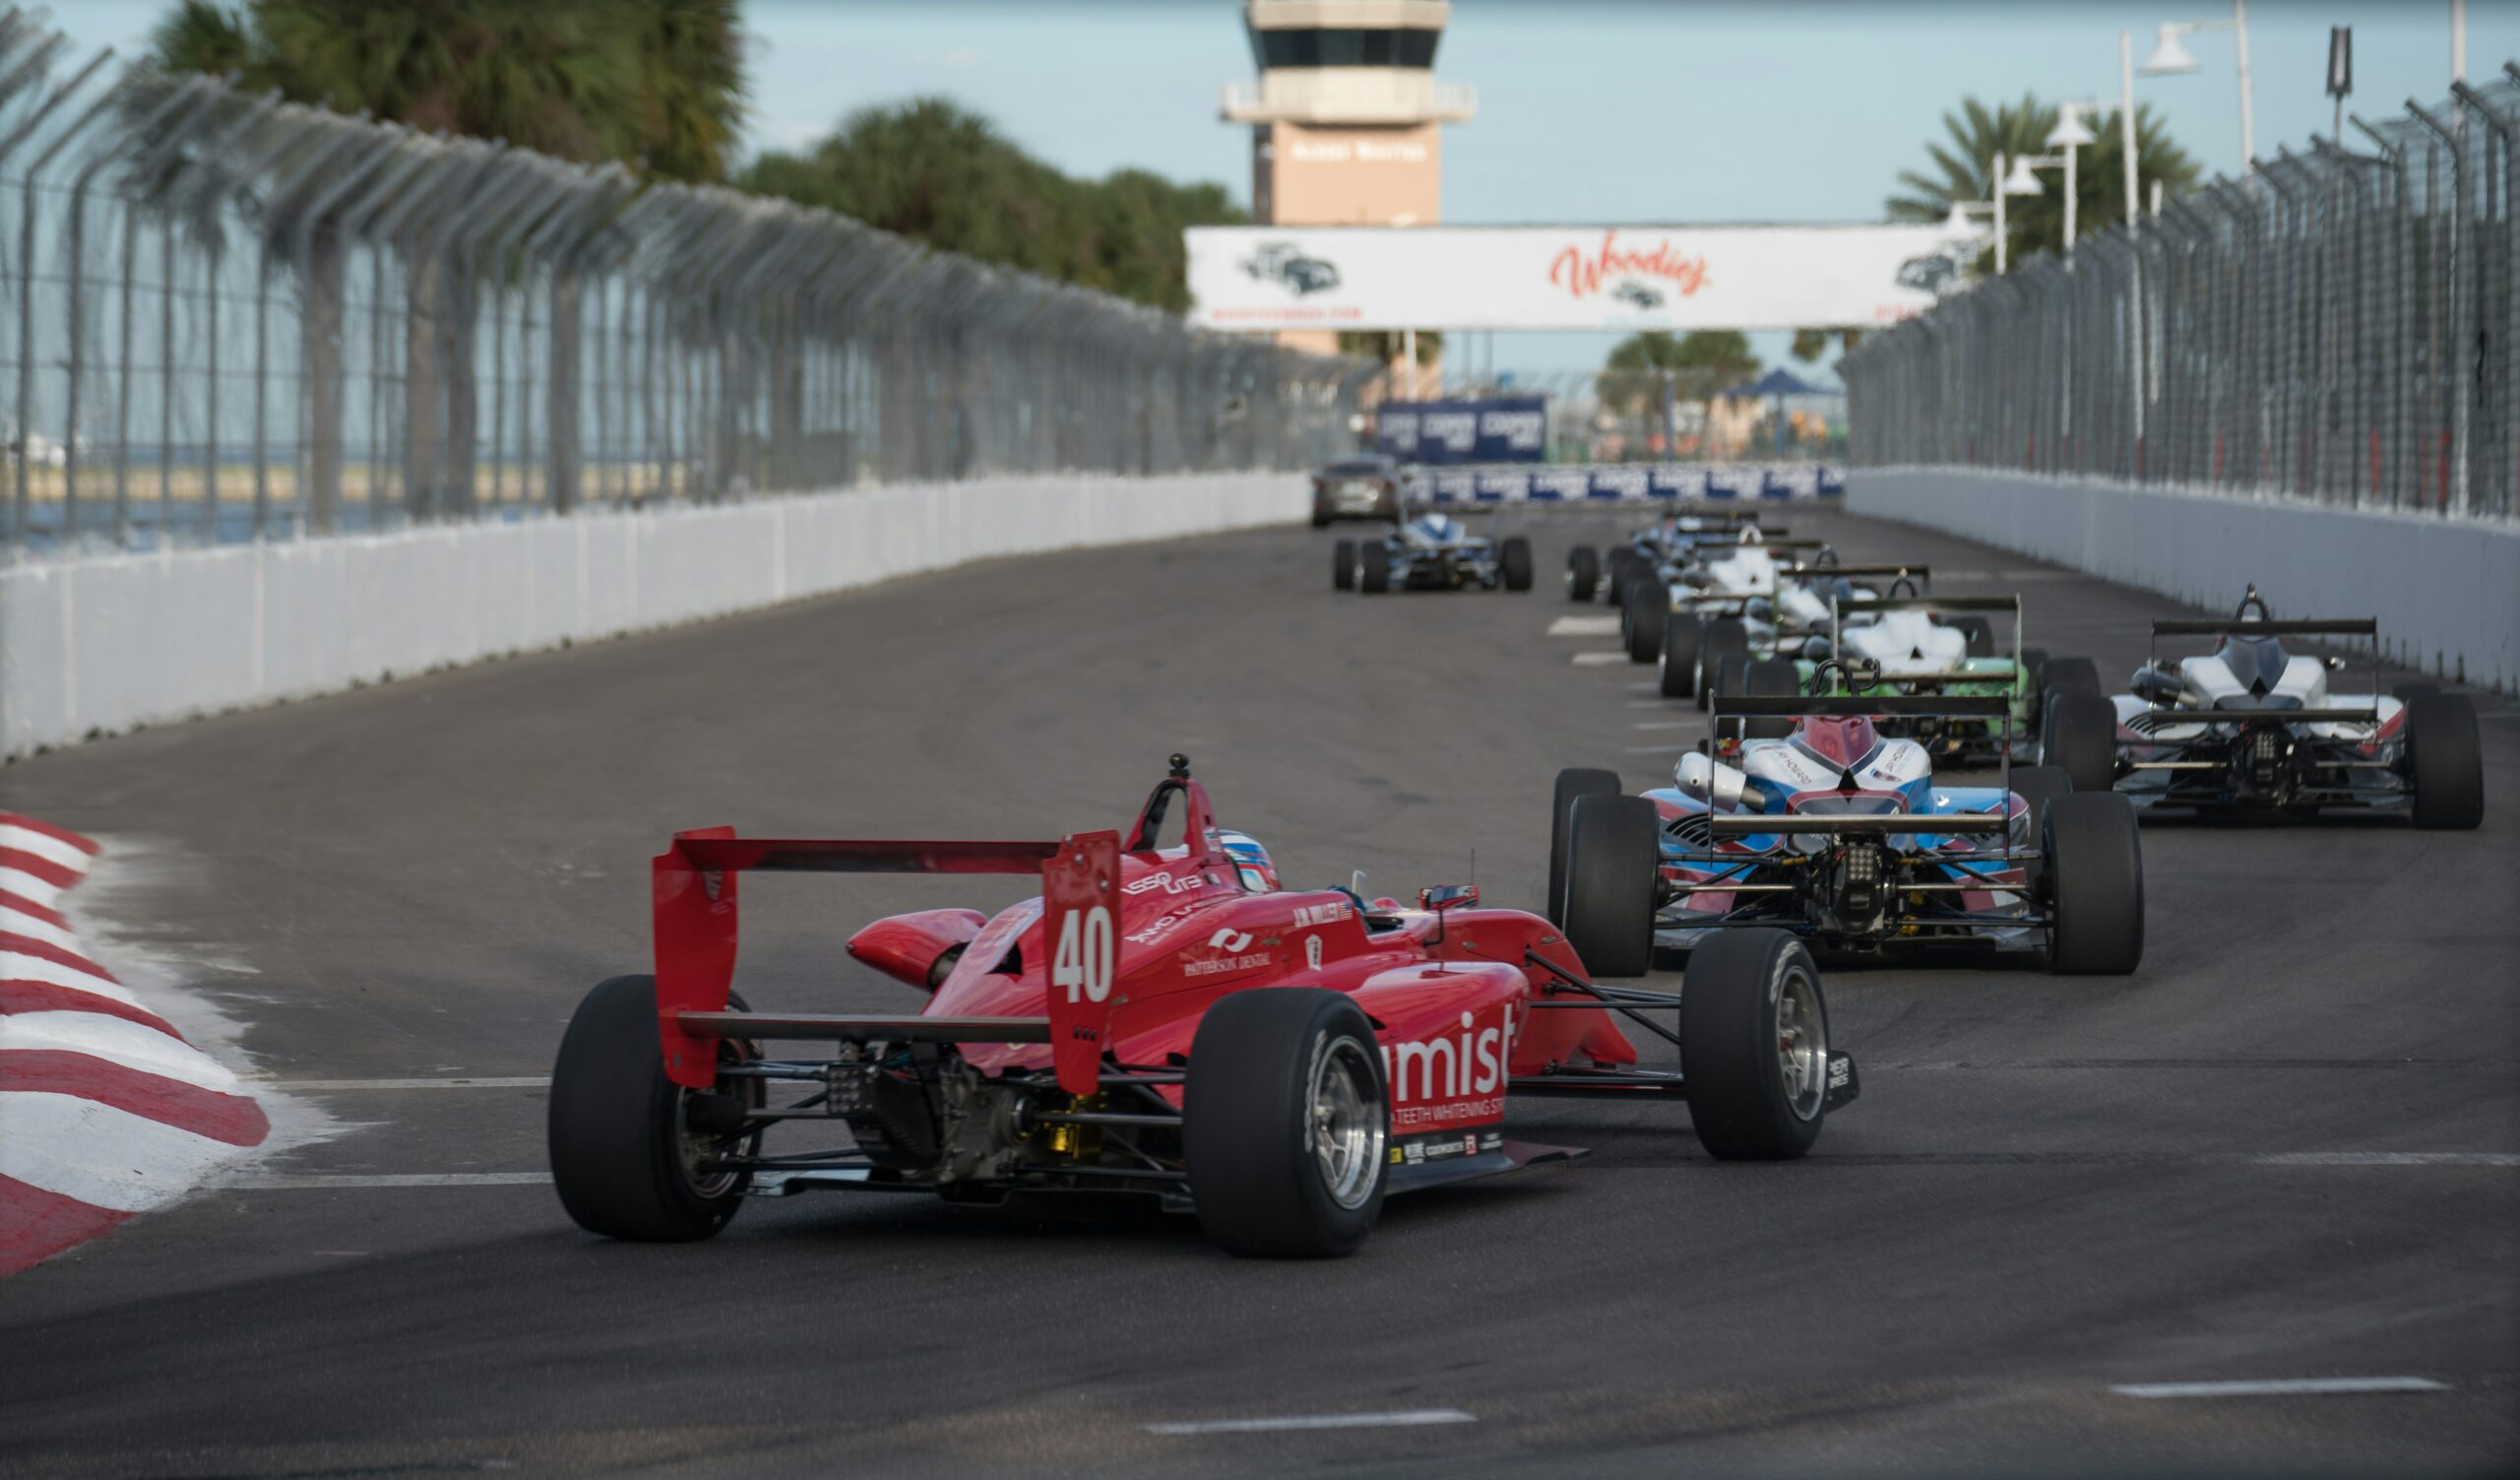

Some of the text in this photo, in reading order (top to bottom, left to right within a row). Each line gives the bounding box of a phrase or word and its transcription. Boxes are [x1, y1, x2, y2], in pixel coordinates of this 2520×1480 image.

[1052, 905, 1113, 1003] 40
[1184, 952, 1271, 977] PATTERSON DENTAL
[1396, 1107, 1432, 1125] TEETH
[1433, 1100, 1490, 1122] WHITENING
